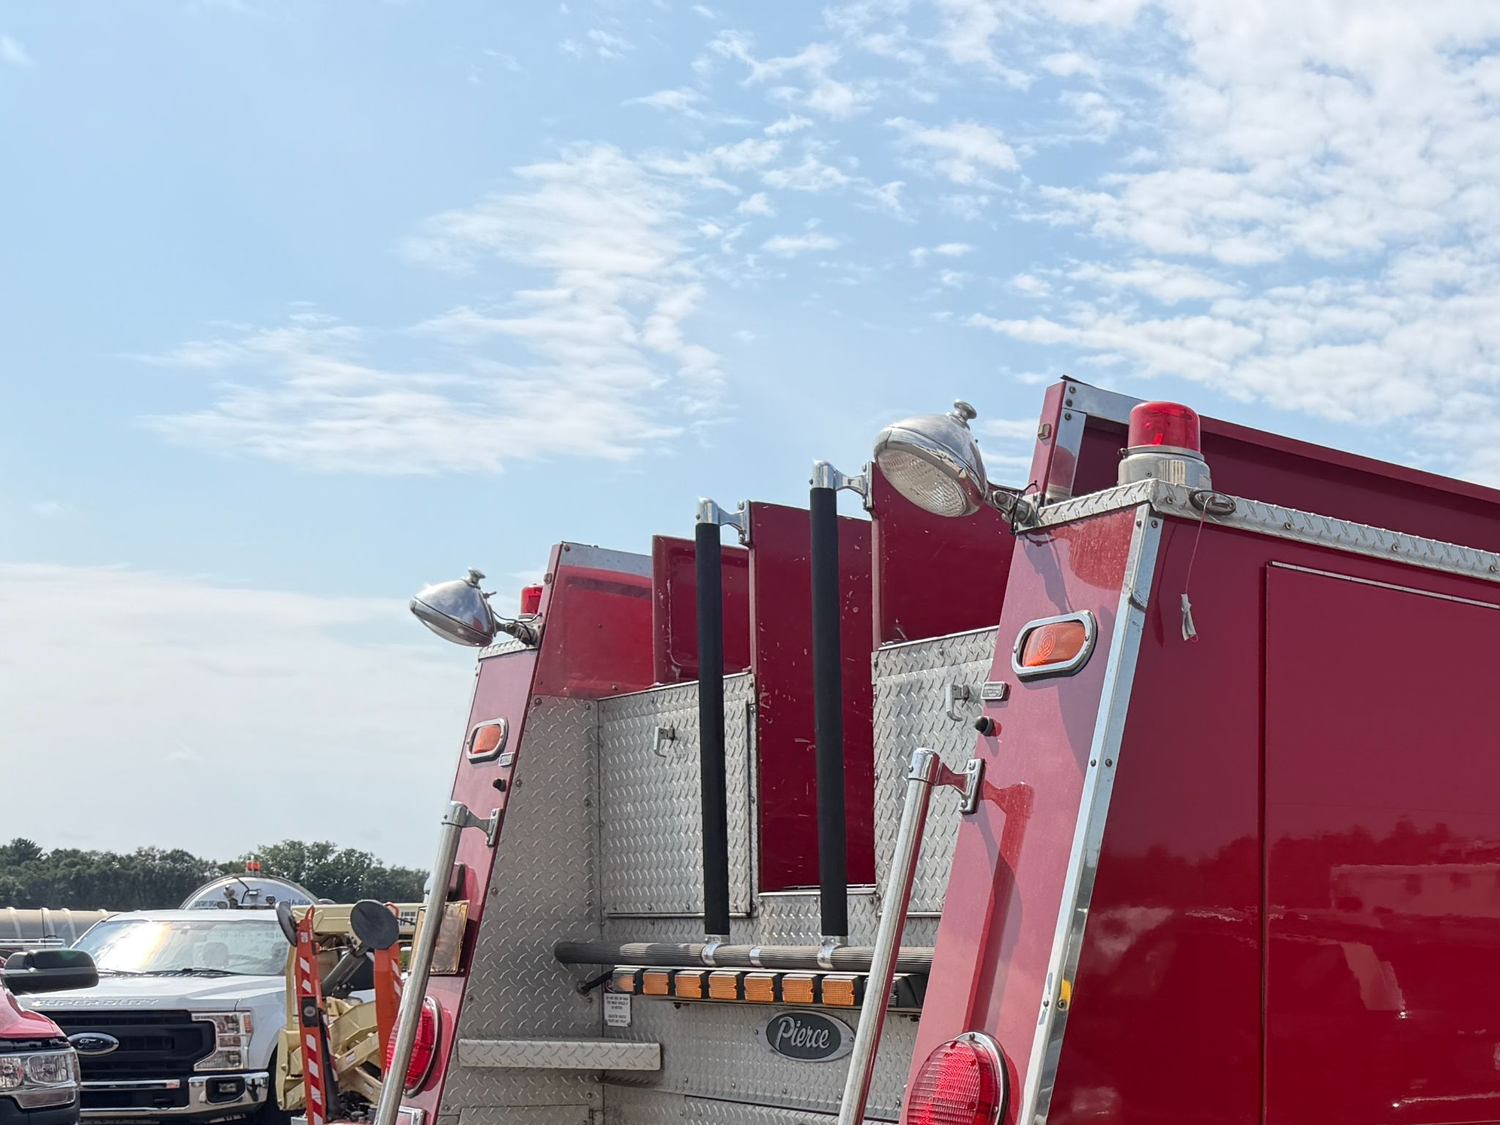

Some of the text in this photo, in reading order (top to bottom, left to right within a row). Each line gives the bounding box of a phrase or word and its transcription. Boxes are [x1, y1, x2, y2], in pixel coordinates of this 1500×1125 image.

[103, 999, 158, 1007] DUTY
[775, 1016, 831, 1051] Pierce
[77, 1038, 104, 1050] Ford
